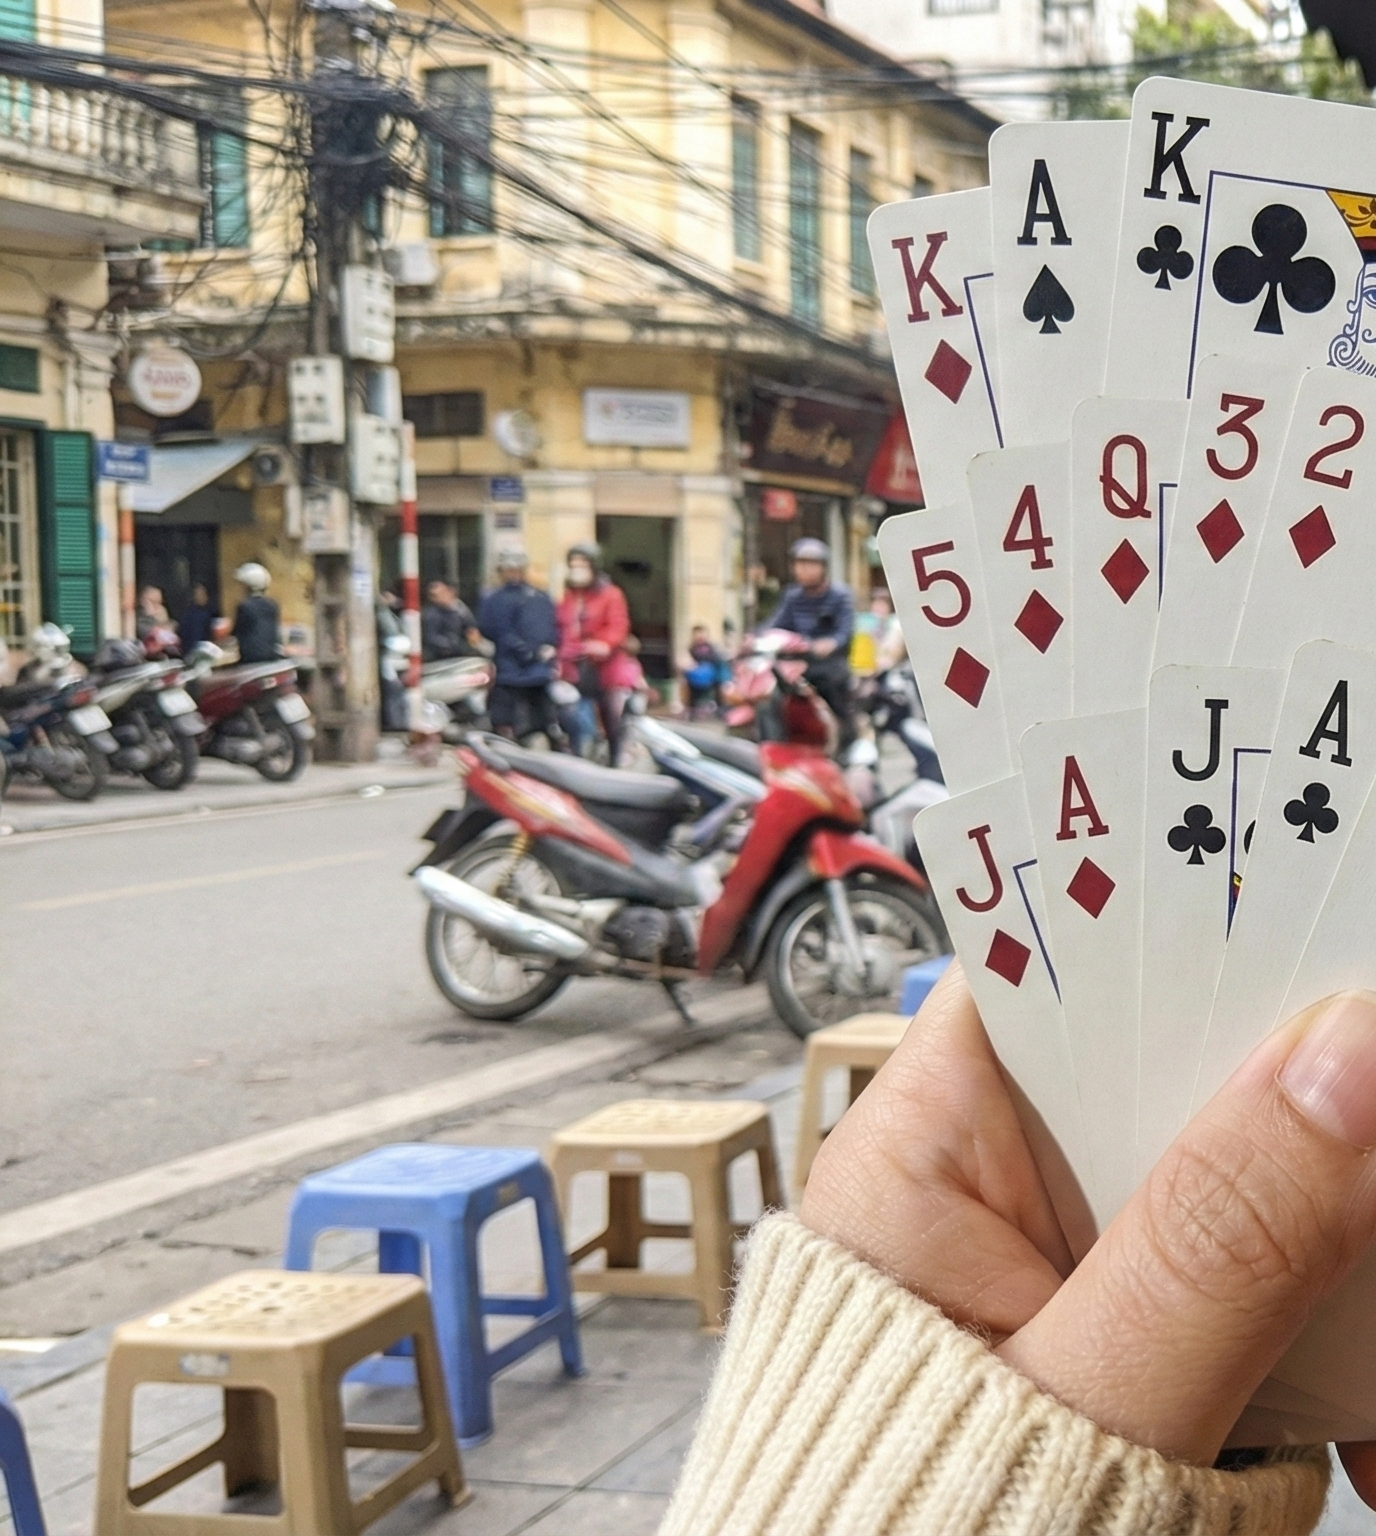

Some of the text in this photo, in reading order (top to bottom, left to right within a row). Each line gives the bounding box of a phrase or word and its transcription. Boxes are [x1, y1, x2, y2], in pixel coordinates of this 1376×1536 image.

[1016, 158, 1073, 246] A
[1143, 111, 1211, 205] K
[891, 231, 964, 323] K
[1099, 434, 1152, 519] Q
[1205, 392, 1265, 481] 3
[1303, 404, 1365, 490] 2
[1002, 484, 1054, 571] 4
[911, 540, 972, 628] 5
[1172, 698, 1229, 782] J
[1298, 679, 1353, 768] A
[1055, 755, 1110, 841] A
[955, 824, 1004, 913] J
